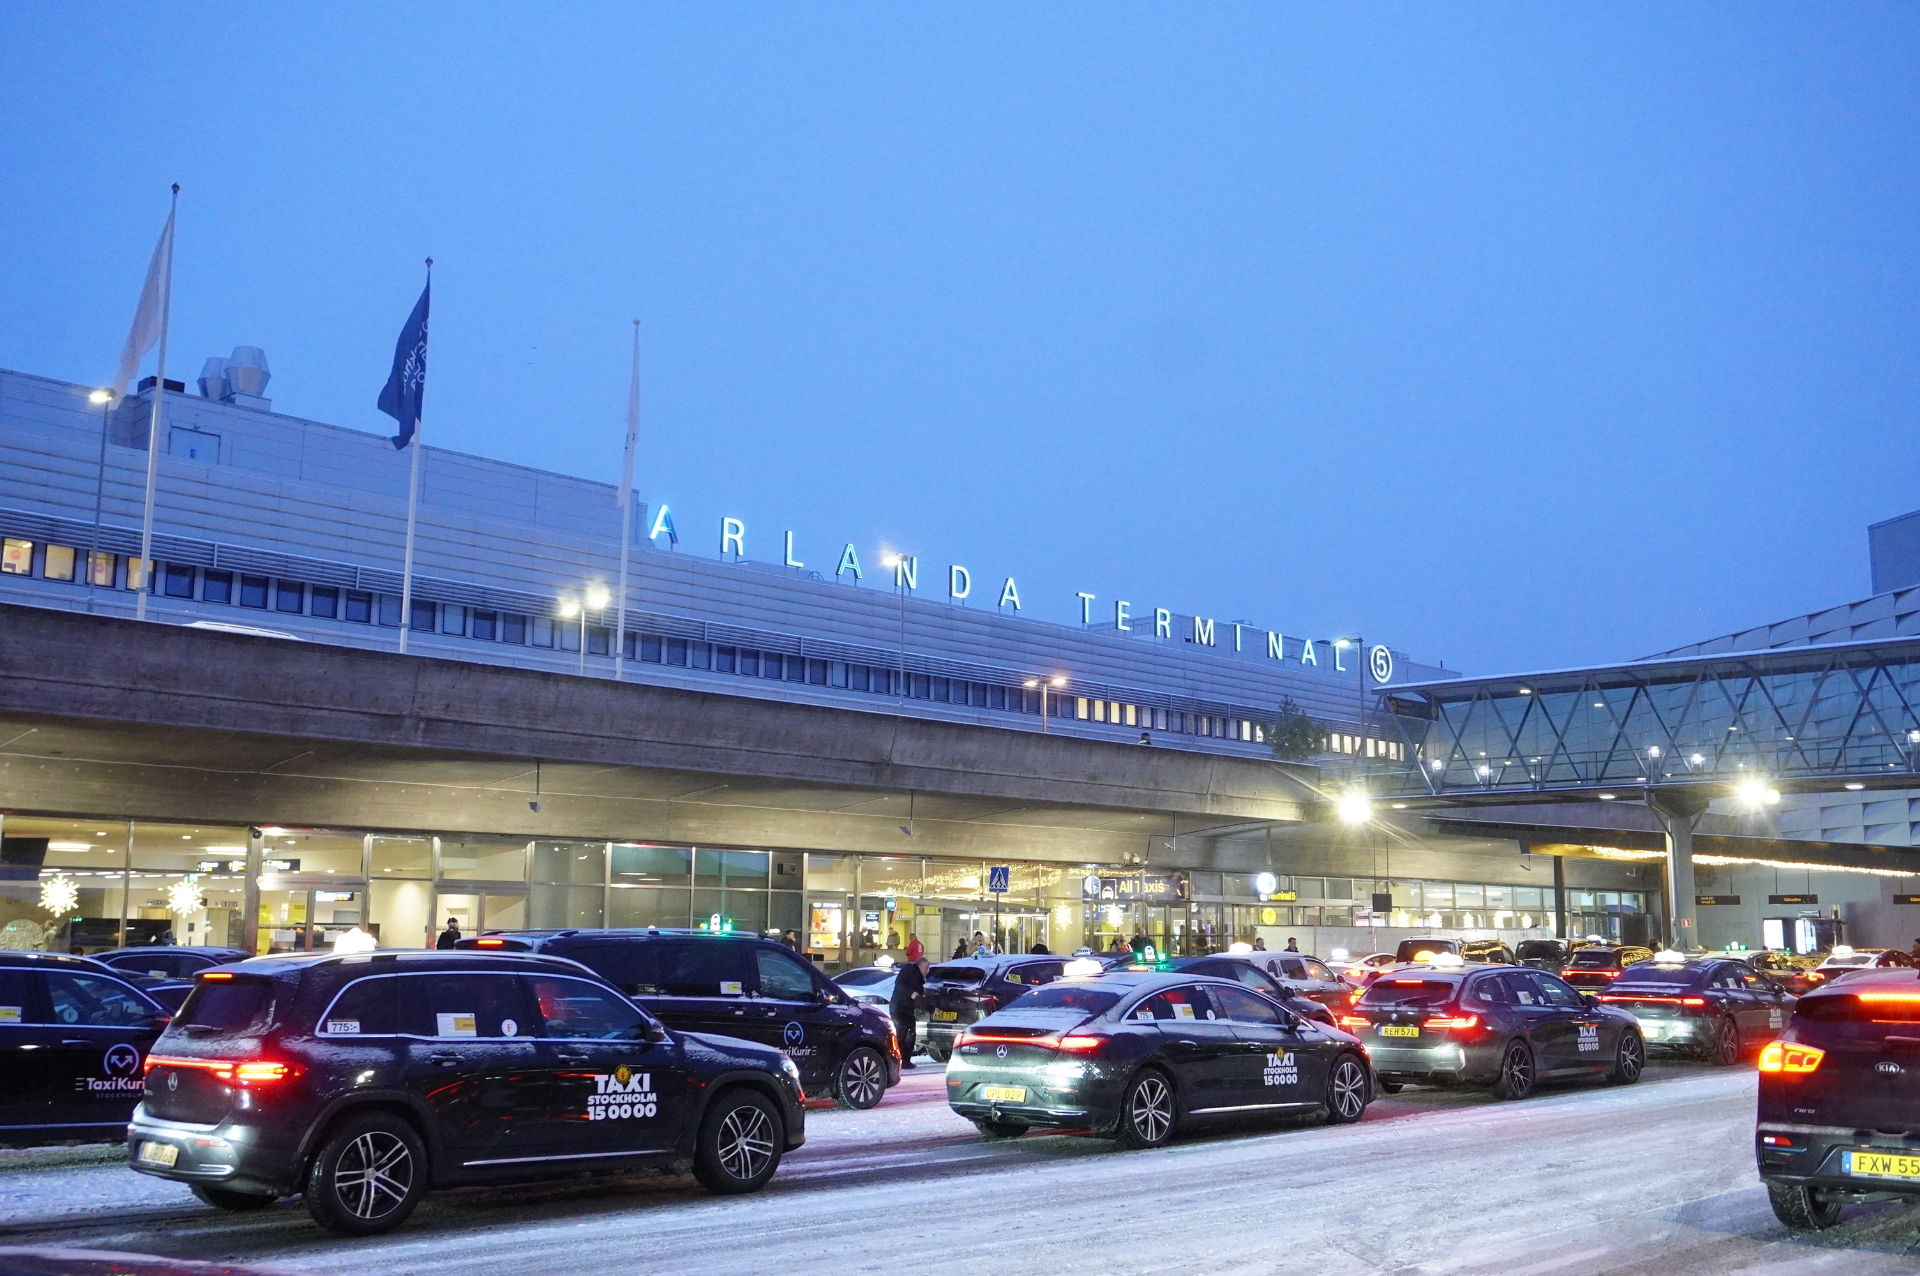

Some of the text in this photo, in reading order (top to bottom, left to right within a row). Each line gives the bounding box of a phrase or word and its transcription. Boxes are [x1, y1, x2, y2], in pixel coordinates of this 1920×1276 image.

[650, 504, 1021, 610] ARLANDA
[1076, 592, 1346, 671] TERMINAL
[1119, 880, 1165, 893] All Taxis
[1291, 891, 1296, 901] 5
[331, 1022, 357, 1032] 775:-
[506, 1023, 512, 1032] F
[1383, 1027, 1399, 1036] REH
[1578, 1026, 1596, 1037] TAXI
[1266, 1052, 1294, 1067] TAXI
[1263, 1066, 1298, 1075] STOCKHOLM
[1878, 1064, 1897, 1073] KIA
[594, 1073, 651, 1093] TAXI
[587, 1092, 657, 1105] STOCKHOLM
[986, 1088, 1022, 1100] CPL 029
[1858, 1156, 1892, 1172] FXW
